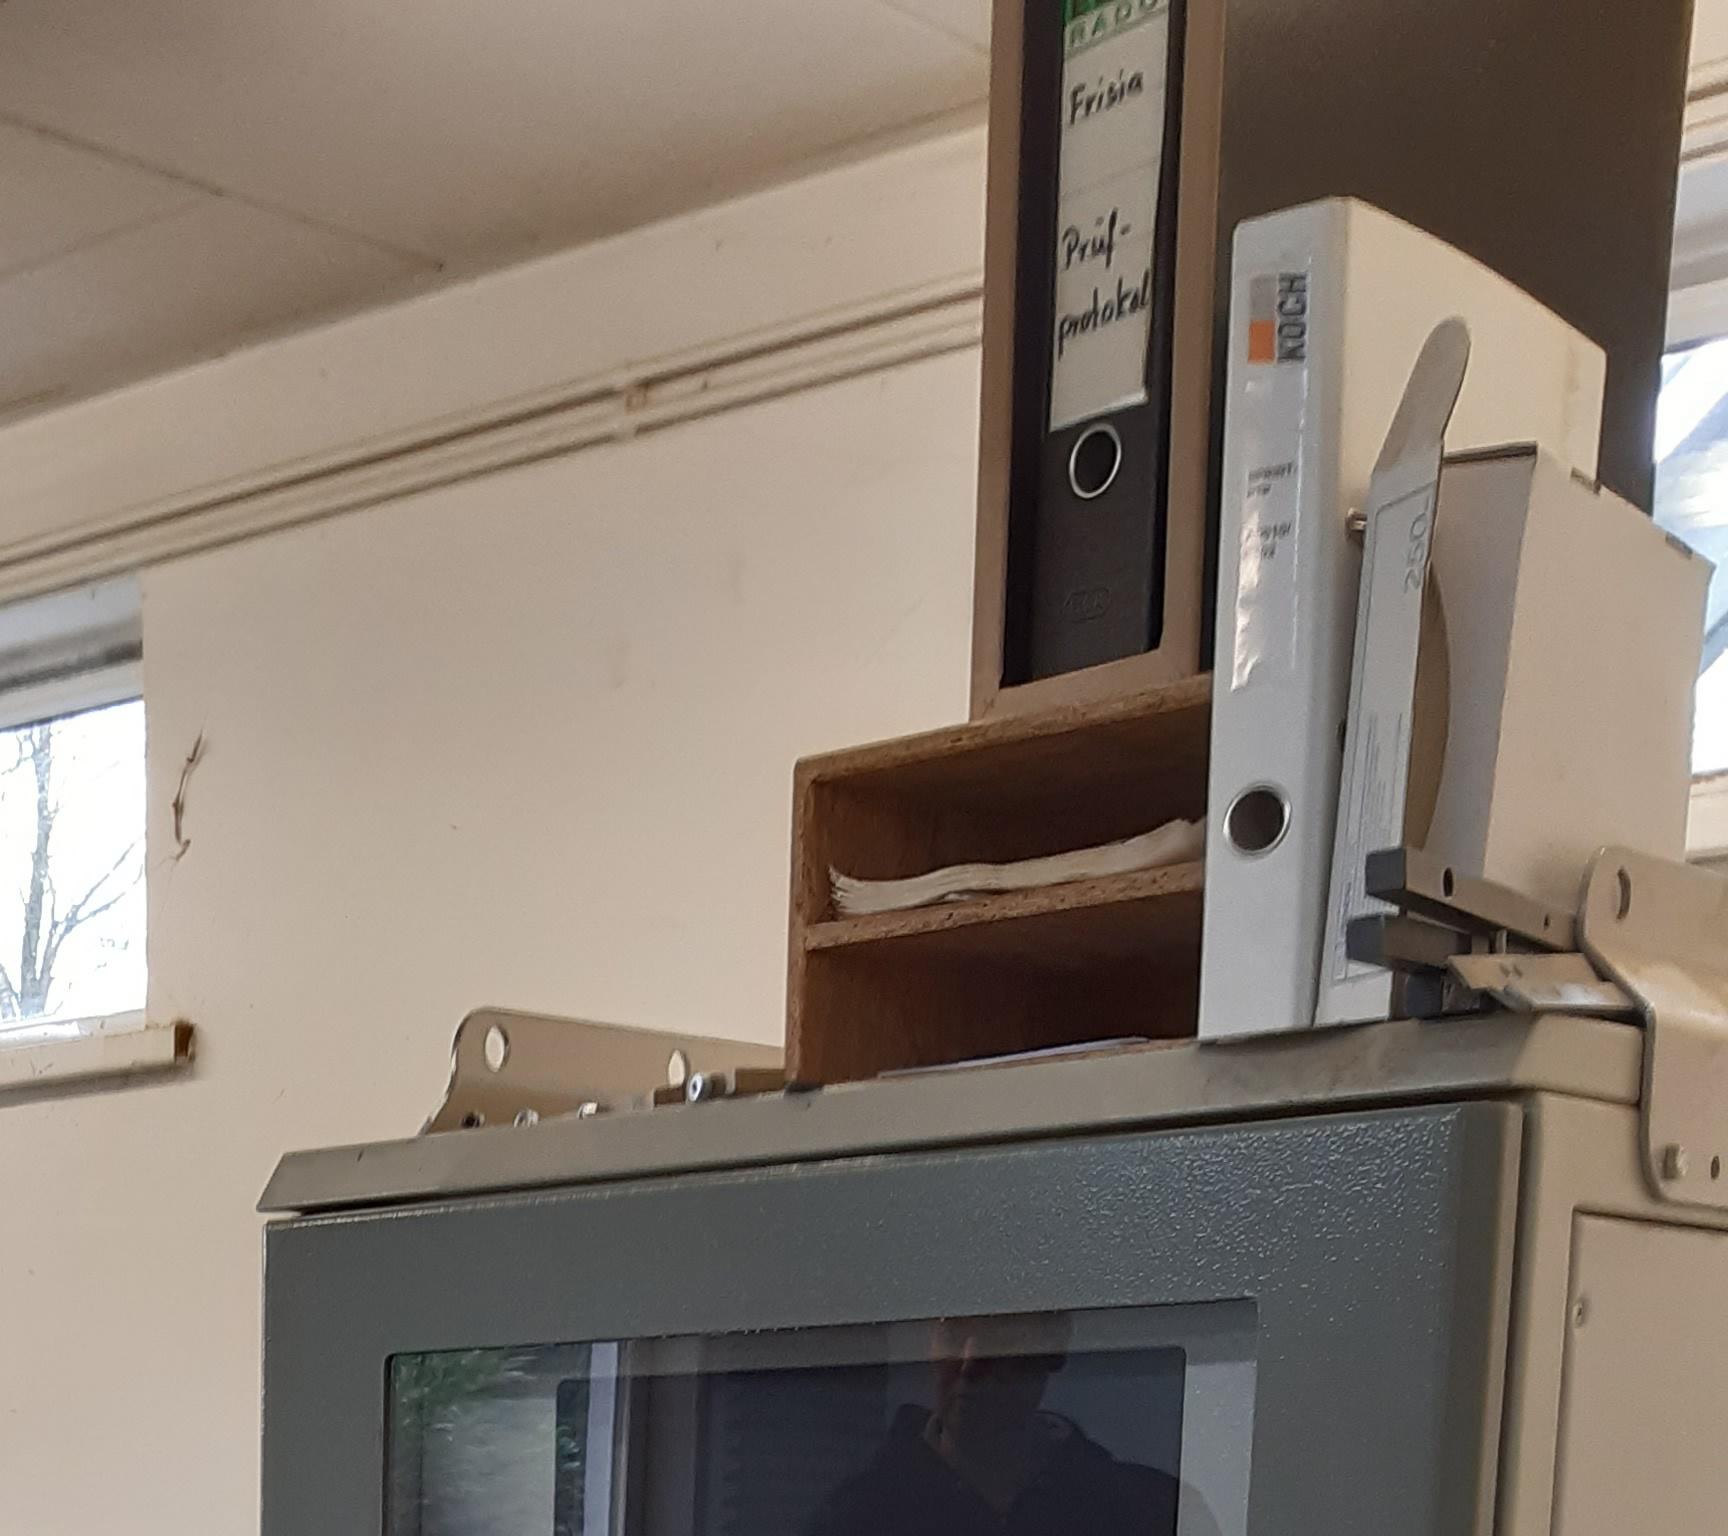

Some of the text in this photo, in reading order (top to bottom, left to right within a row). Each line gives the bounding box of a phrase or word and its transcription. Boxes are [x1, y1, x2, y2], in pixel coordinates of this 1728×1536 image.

[1069, 68, 1144, 126] Frisia
[1062, 206, 1132, 271] Prüf-
[1276, 271, 1307, 365] KOCH
